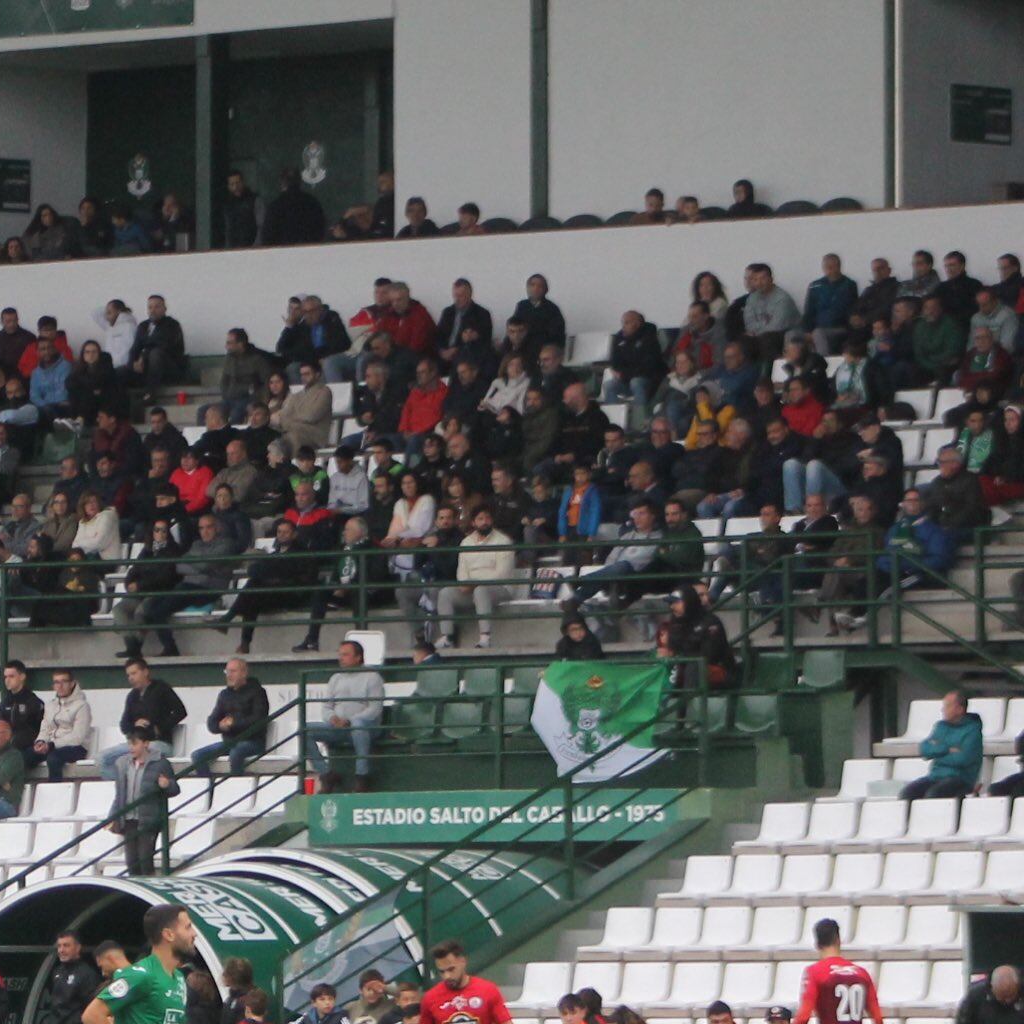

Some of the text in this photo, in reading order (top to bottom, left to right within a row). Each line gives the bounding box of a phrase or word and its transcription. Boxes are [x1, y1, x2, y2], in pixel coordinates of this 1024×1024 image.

[352, 807, 426, 826] ESTADIO
[429, 806, 485, 825] SALTO
[834, 983, 864, 1022] 20
